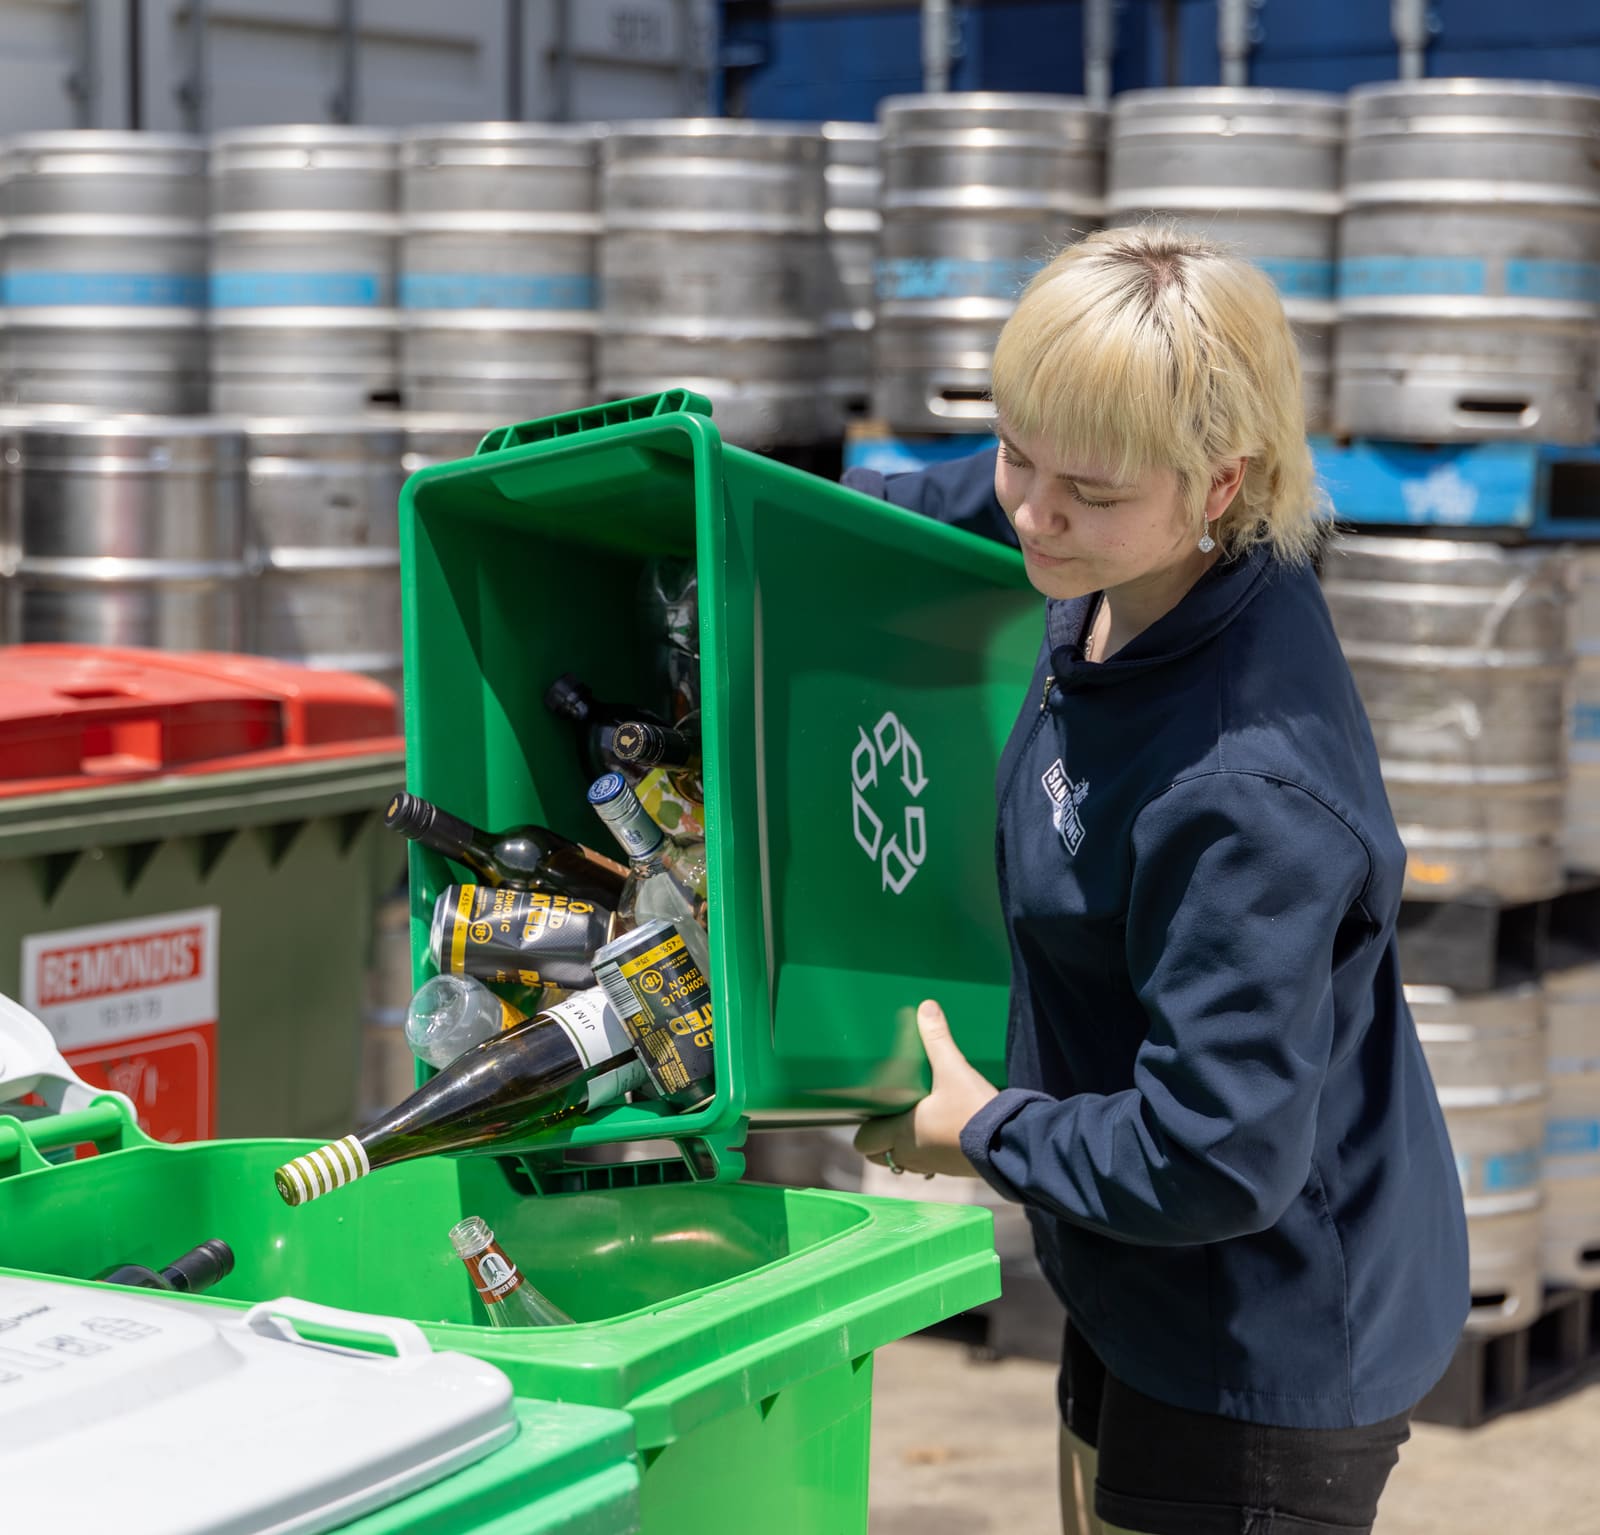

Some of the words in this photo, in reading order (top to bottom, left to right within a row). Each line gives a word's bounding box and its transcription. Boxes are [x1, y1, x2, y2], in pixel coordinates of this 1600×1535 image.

[43, 931, 197, 999] REMONDIS
[668, 968, 699, 991] LEMON
[573, 1009, 596, 1031] JIM
[668, 1002, 713, 1036] TED
